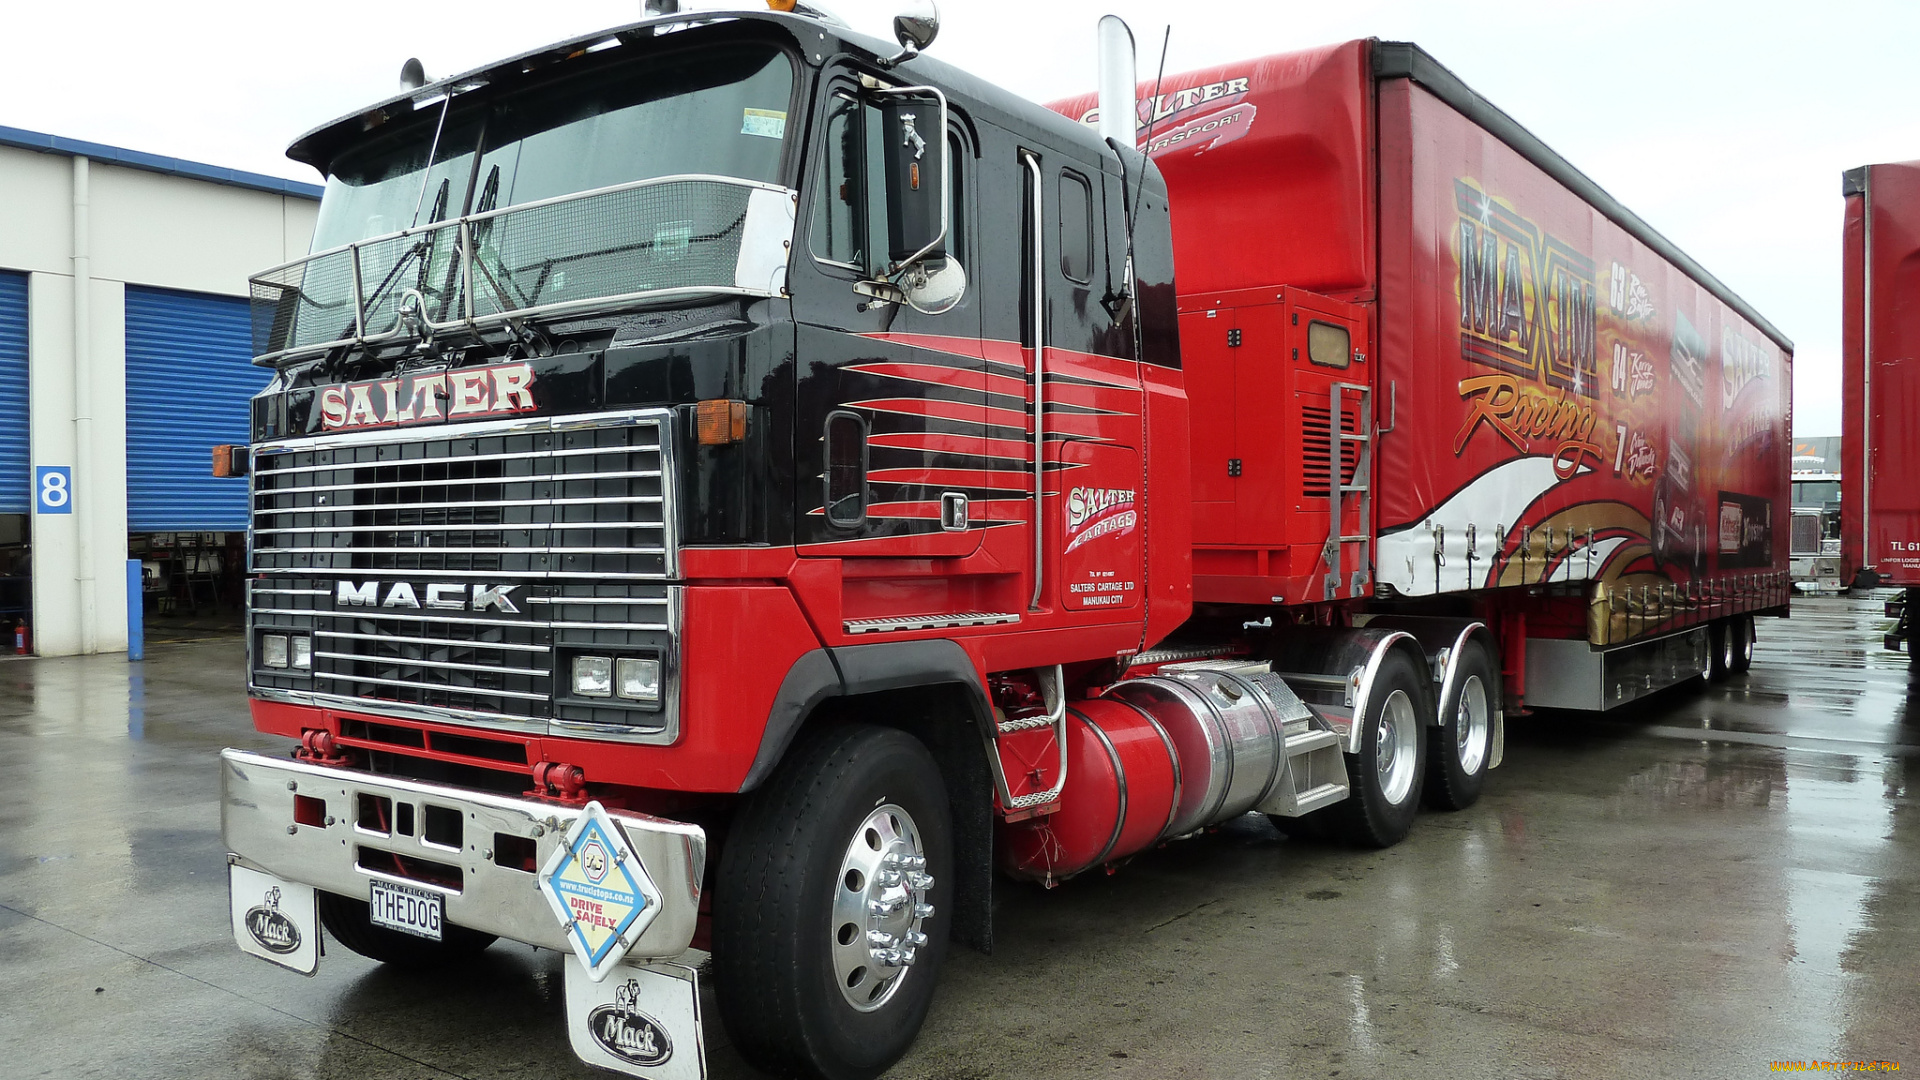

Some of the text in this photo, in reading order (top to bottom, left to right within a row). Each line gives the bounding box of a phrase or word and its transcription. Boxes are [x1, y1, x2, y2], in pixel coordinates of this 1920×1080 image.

[1079, 78, 1249, 131] LTER
[1139, 112, 1242, 153] ORSPORT
[1459, 213, 1599, 385] MAXIM
[1611, 262, 1625, 311] 63
[1612, 343, 1627, 392] 84
[322, 363, 537, 430] SALTER
[1454, 374, 1602, 480] Racing
[1614, 425, 1626, 472] 7
[41, 472, 68, 507] 8
[1069, 486, 1134, 529] SALTER
[1075, 512, 1132, 547] CARTAGE
[1891, 541, 1905, 551] TL
[338, 581, 521, 613] MACK
[1070, 581, 1134, 592] SALTERS CARTAGE LTD
[1083, 595, 1123, 605] MANUKAU CITY
[376, 880, 434, 899] MACK TRUCKS
[571, 897, 603, 914] DRIVE
[254, 913, 291, 946] Mack
[375, 890, 439, 931] THEDOG
[602, 1014, 659, 1057] Mack
